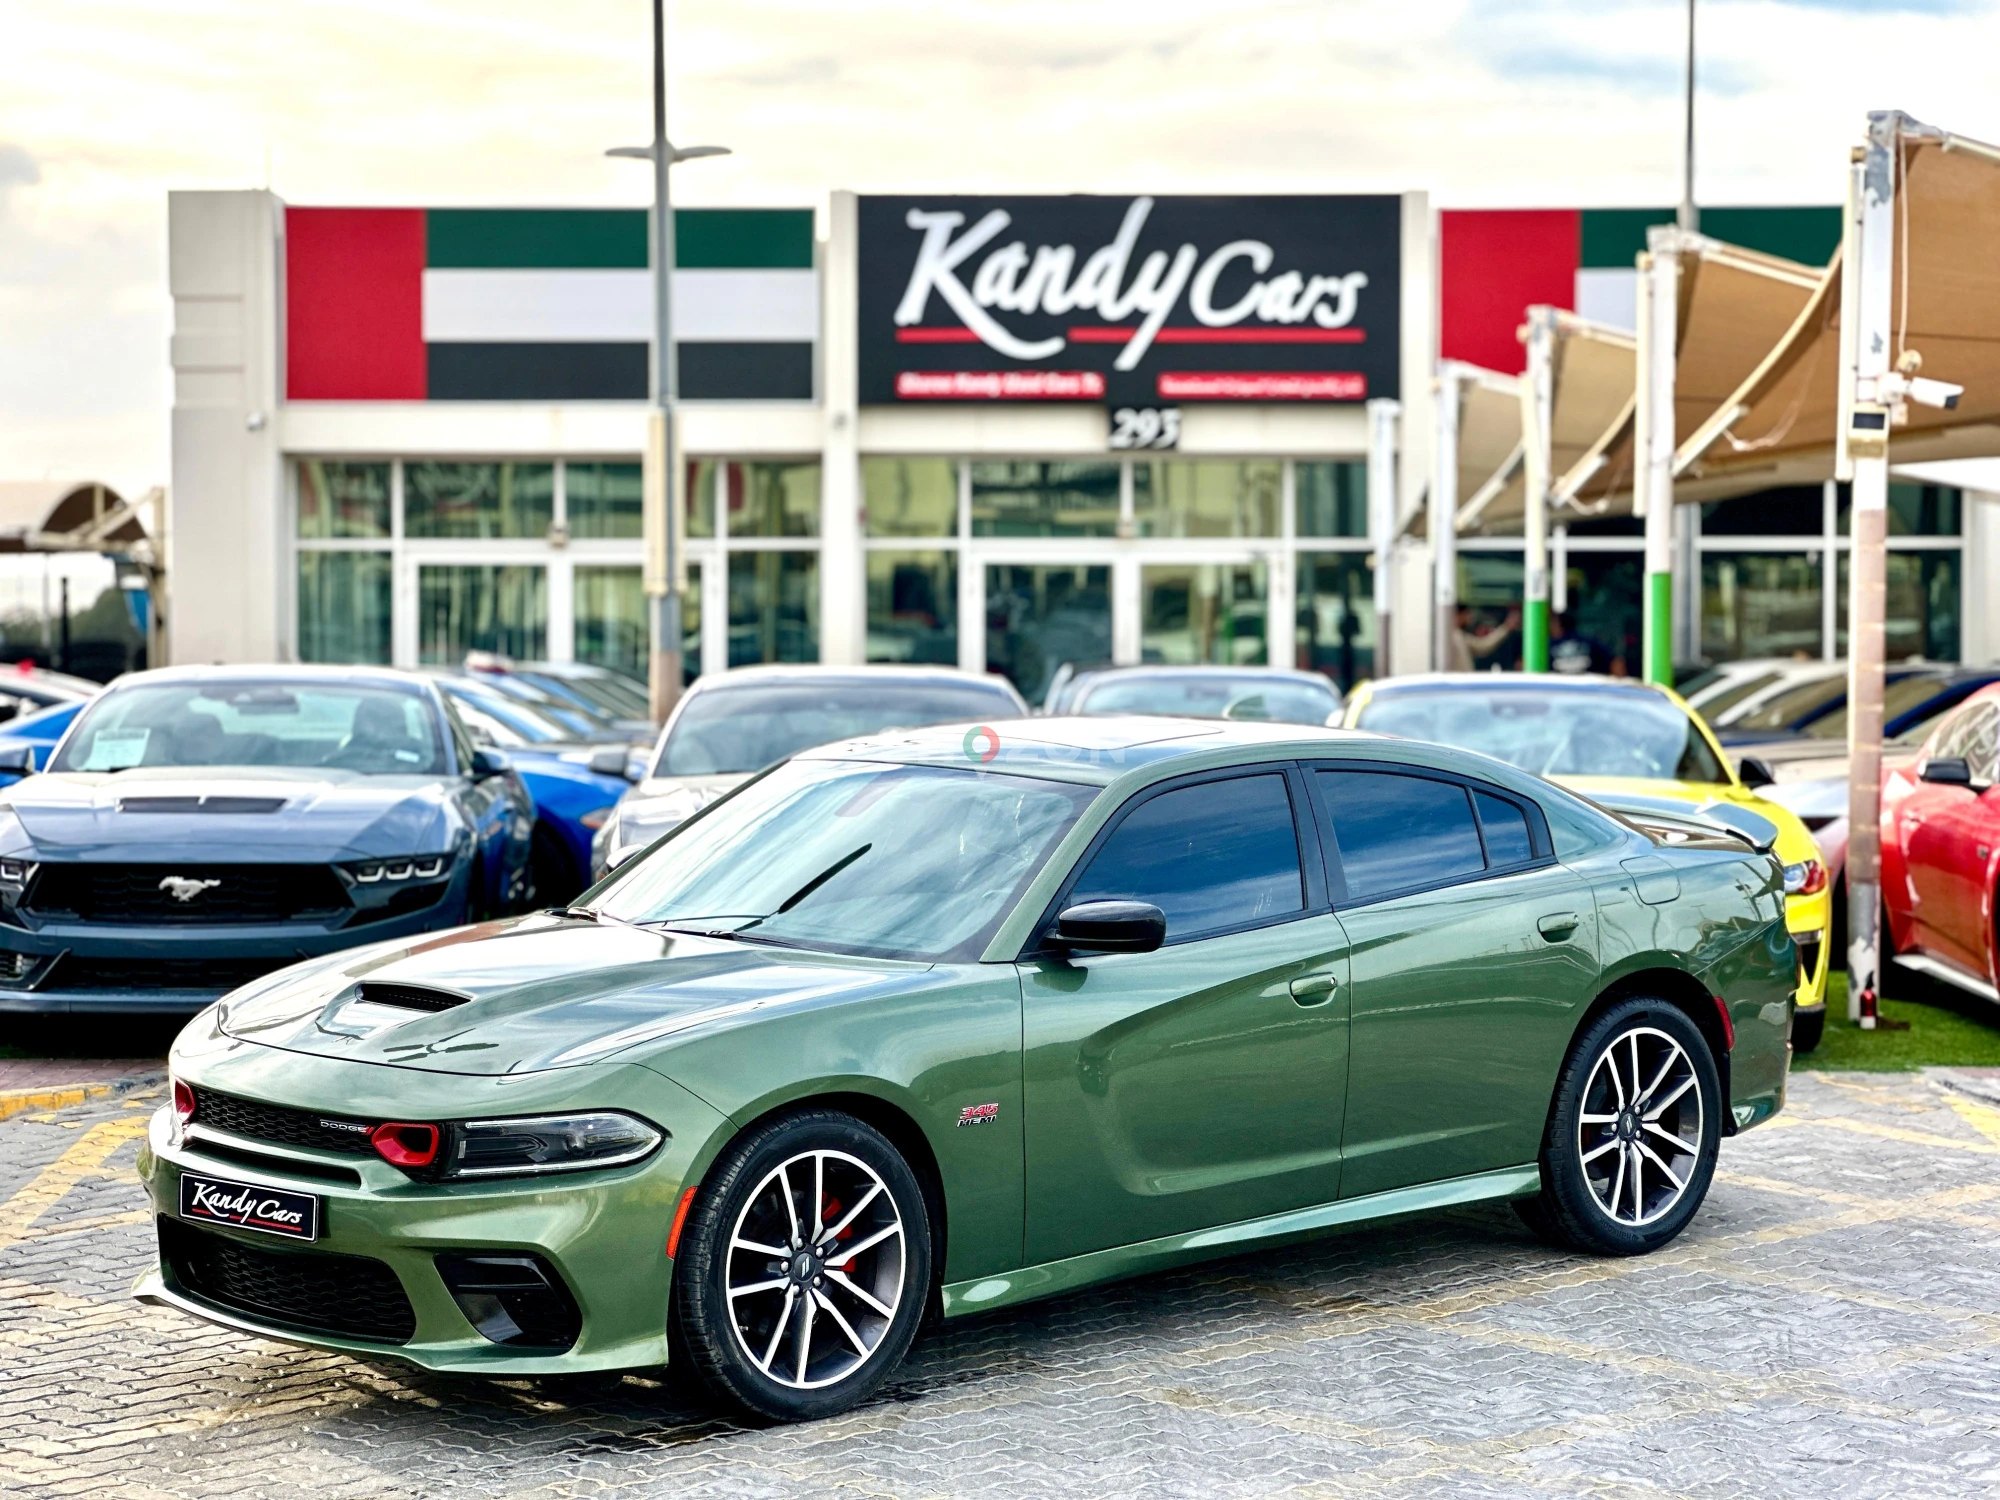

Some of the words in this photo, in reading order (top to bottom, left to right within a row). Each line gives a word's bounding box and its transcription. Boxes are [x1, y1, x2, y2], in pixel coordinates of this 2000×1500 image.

[894, 196, 1199, 370] Kandy
[1190, 240, 1368, 327] Cars
[960, 1103, 998, 1120] 345
[320, 1121, 366, 1133] DODGE
[956, 1115, 996, 1128] HEMI
[192, 1182, 257, 1223] Kandy
[256, 1200, 302, 1223] Cars
